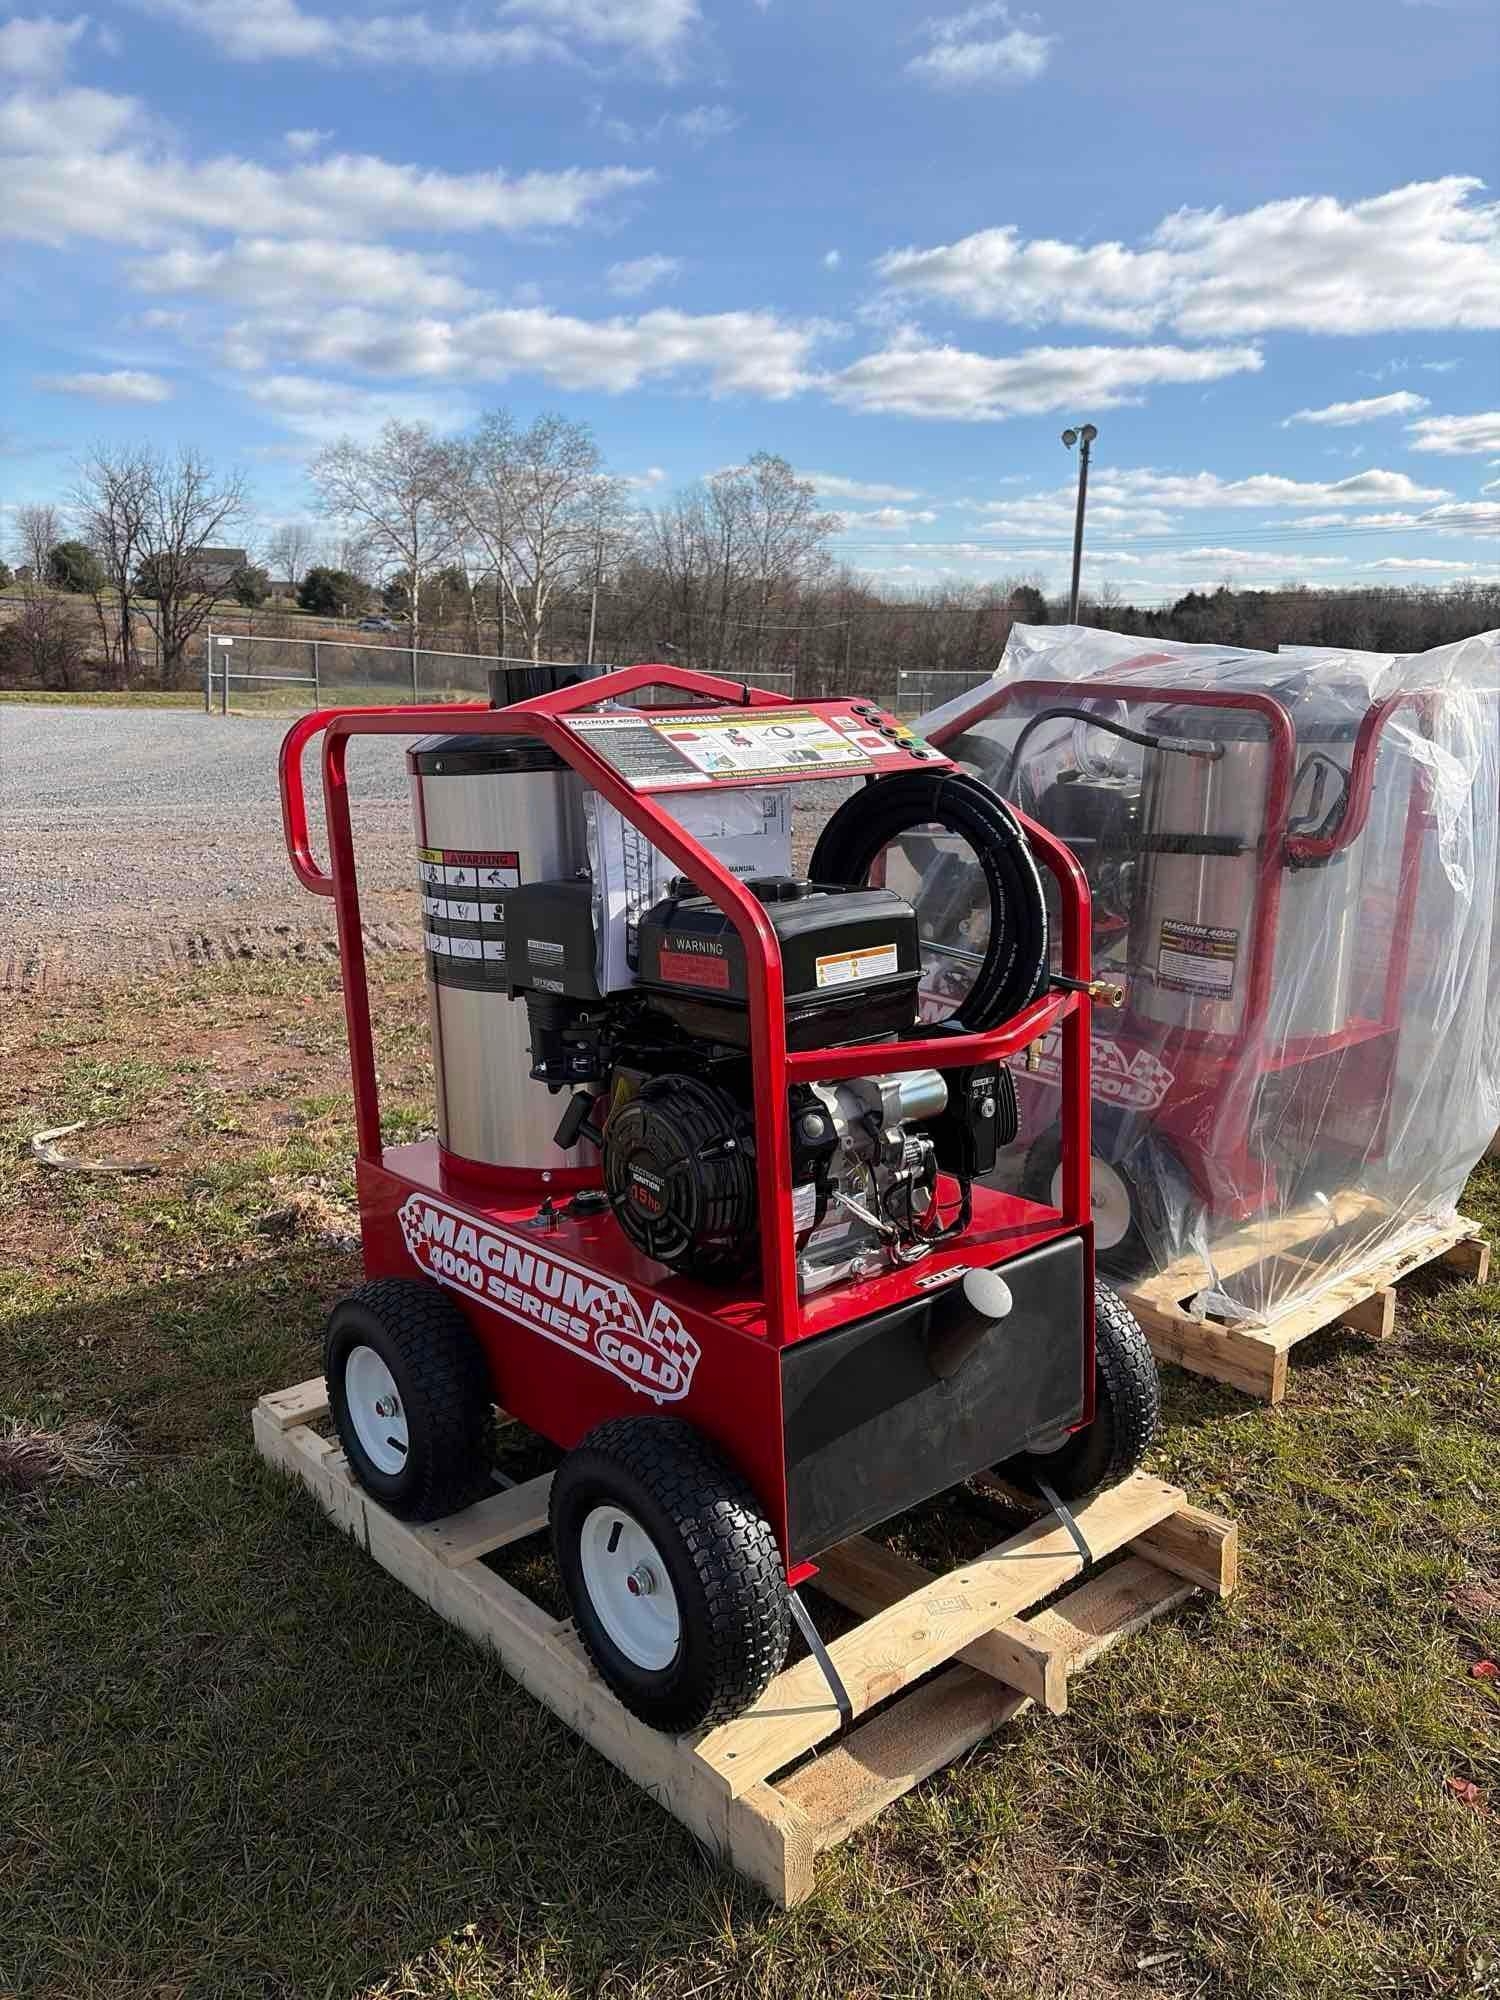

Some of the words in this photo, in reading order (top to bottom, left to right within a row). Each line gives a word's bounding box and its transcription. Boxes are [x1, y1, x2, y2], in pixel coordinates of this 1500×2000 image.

[568, 718, 615, 726] MAGNUM
[728, 864, 757, 873] MANUAL
[1163, 920, 1208, 936] MAGNUM
[675, 937, 724, 955] WARNING
[628, 1162, 665, 1187] ELECTRONIC
[632, 1172, 660, 1192] IGNITION
[422, 1207, 602, 1315] MAGNUM
[430, 1246, 484, 1291] 4000
[487, 1275, 591, 1343] SERIES
[600, 1334, 678, 1390] GOLD
